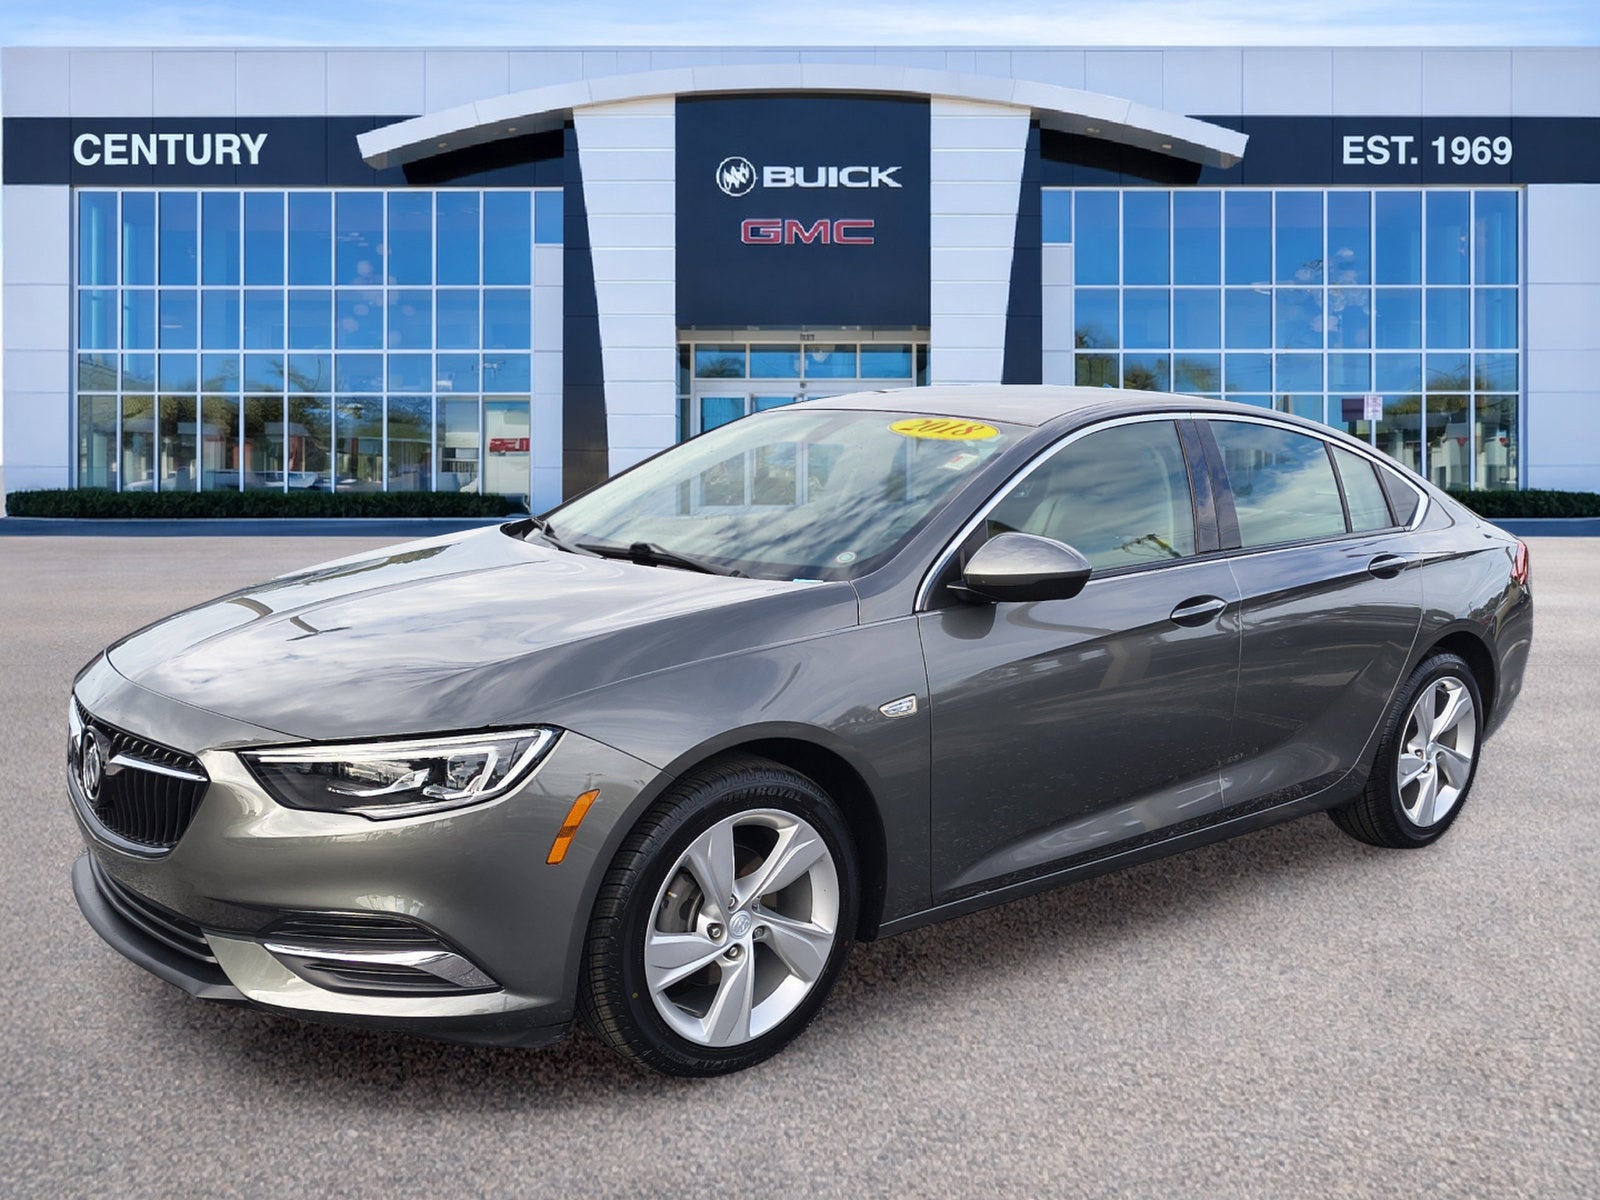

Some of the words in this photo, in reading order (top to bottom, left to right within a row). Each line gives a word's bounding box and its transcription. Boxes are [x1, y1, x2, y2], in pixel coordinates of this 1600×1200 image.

[73, 133, 268, 166] CENTURY
[1342, 135, 1418, 165] EST.
[1430, 135, 1513, 166] 1969
[762, 165, 904, 188] BUICK
[740, 218, 875, 245] GMC
[899, 420, 985, 435] 2018
